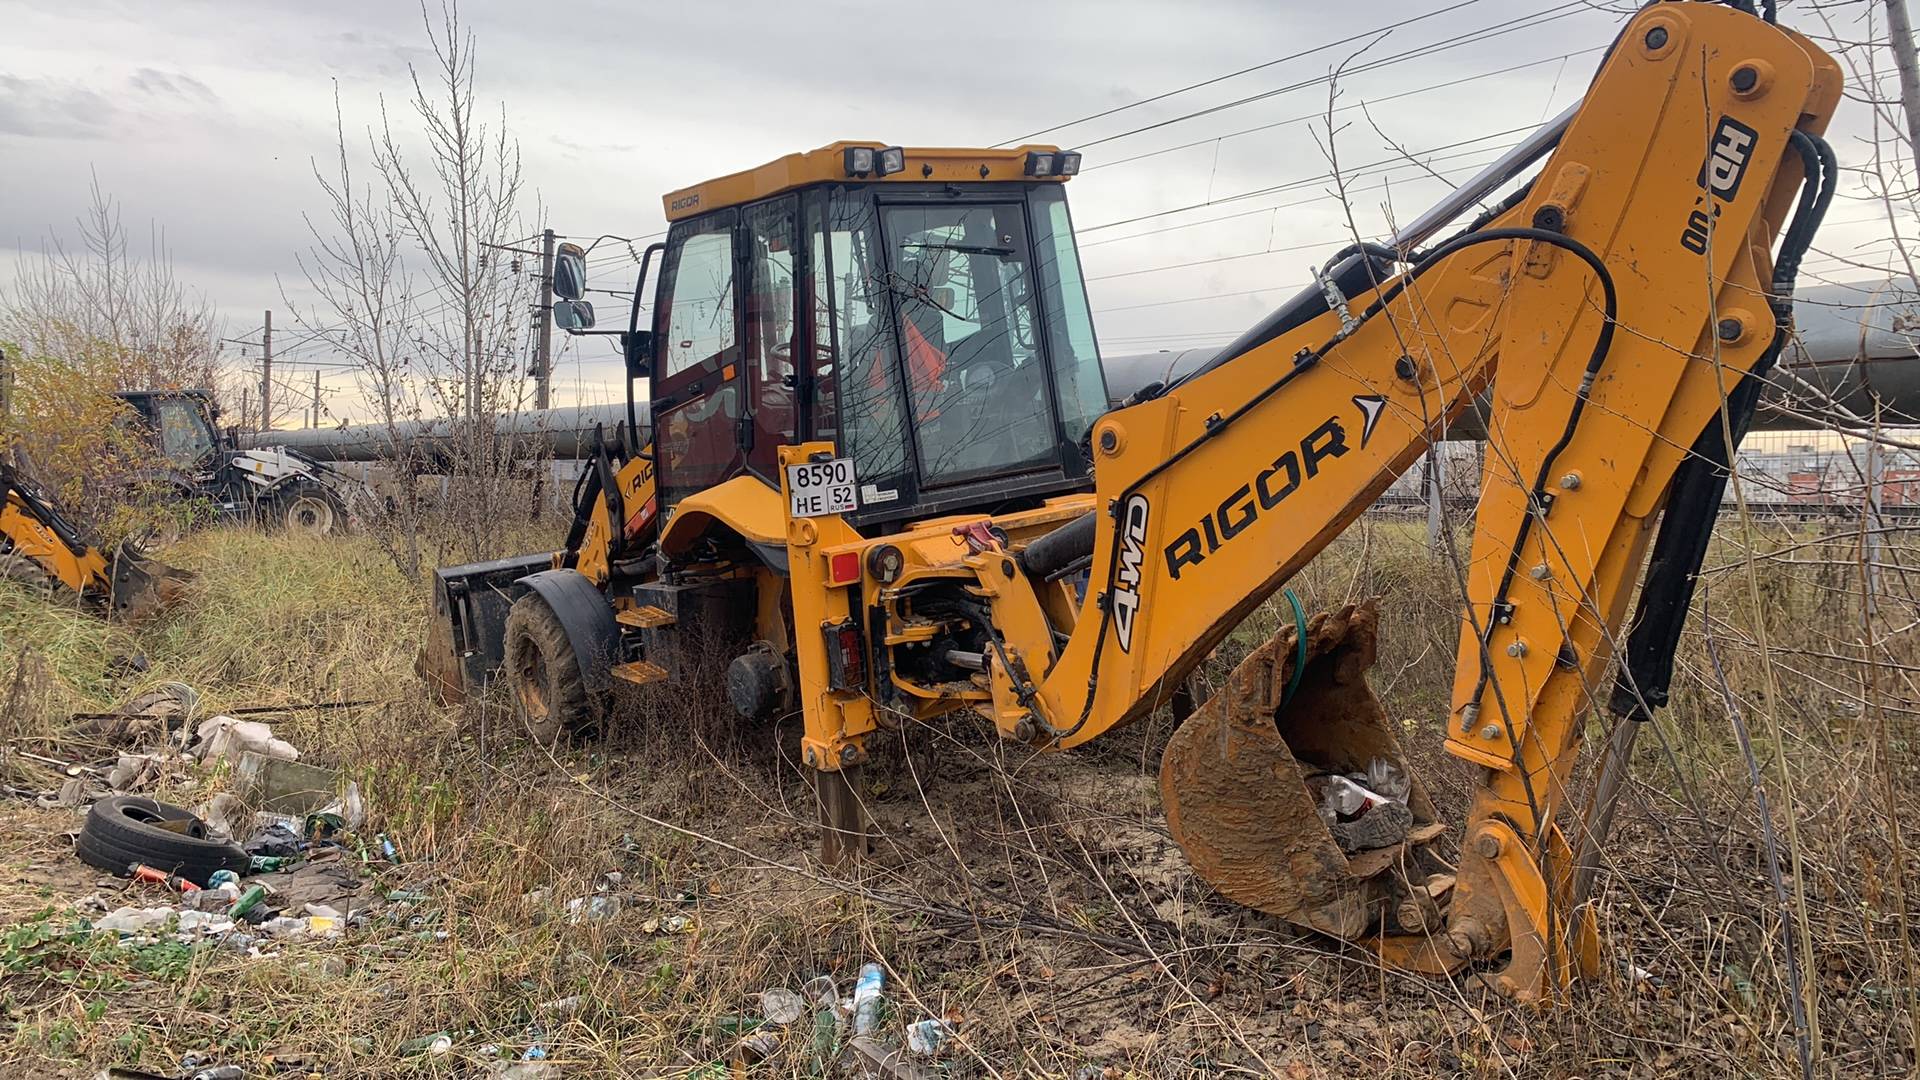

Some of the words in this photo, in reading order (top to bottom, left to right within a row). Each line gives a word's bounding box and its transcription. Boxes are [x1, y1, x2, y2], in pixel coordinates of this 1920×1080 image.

[1708, 124, 1752, 191] HD
[671, 194, 700, 212] RIGOR
[632, 461, 653, 493] RIG
[797, 463, 847, 488] 8590
[797, 496, 822, 513] HE
[830, 503, 845, 511] RUS
[833, 486, 852, 504] 52
[1164, 416, 1350, 580] RIGOR
[1113, 493, 1149, 655] 4WD
